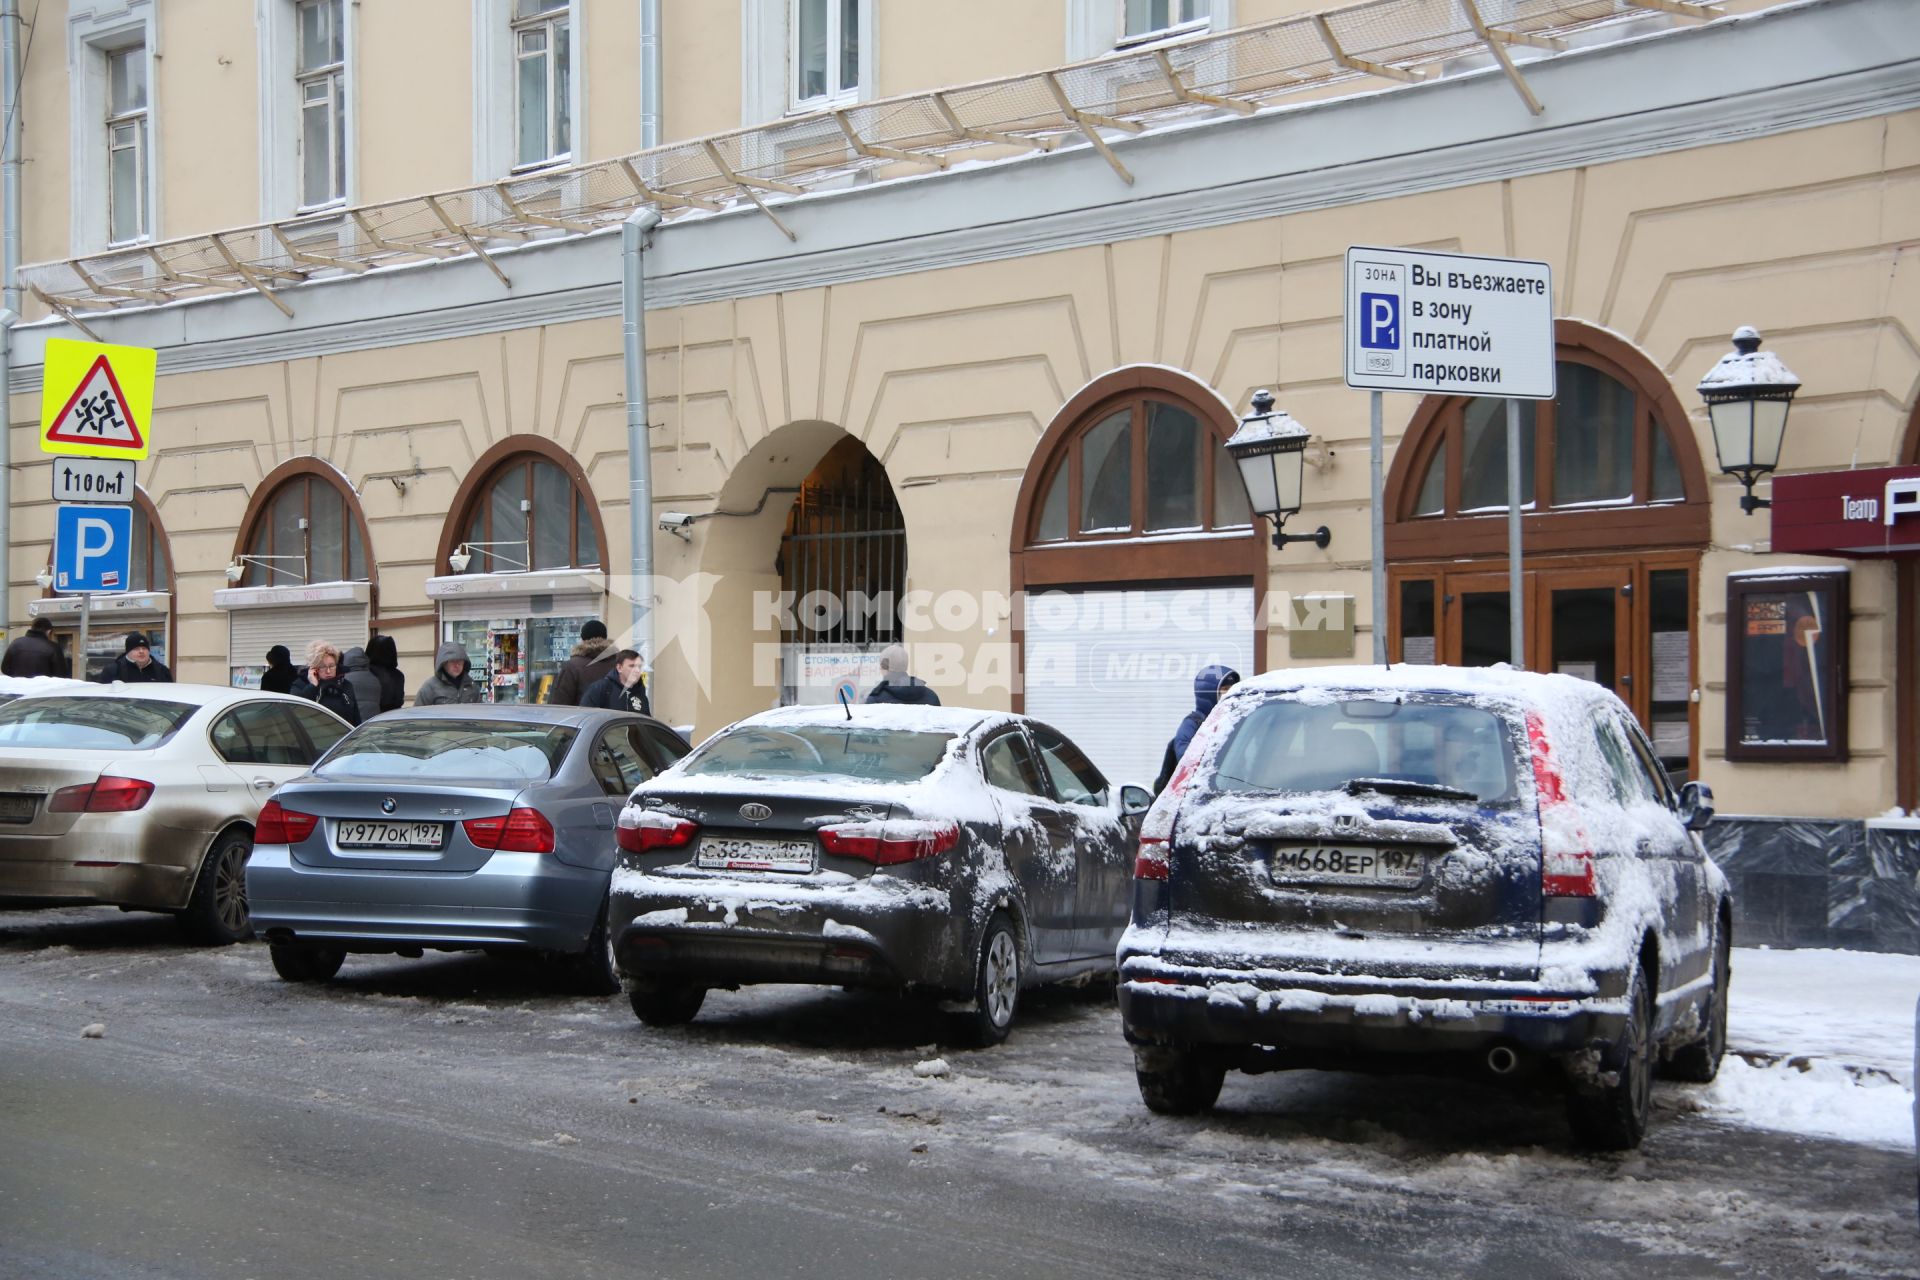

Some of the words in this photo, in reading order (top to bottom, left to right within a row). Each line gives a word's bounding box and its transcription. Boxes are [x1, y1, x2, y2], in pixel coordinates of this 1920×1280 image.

[1364, 267, 1397, 282] ЗОНА
[1412, 264, 1442, 288] Вы
[1448, 271, 1546, 296] въезжаете
[1412, 301, 1424, 317] в
[1429, 302, 1472, 326] зону
[1412, 331, 1492, 353] платной
[1412, 362, 1501, 386] парковки
[1840, 495, 1878, 522] Театр
[75, 517, 114, 580] P
[804, 655, 849, 666] СТОЯНКА
[743, 805, 767, 817] KIA
[413, 824, 439, 839] 197
[1379, 850, 1417, 870] 197
[1386, 868, 1405, 877] RUS
